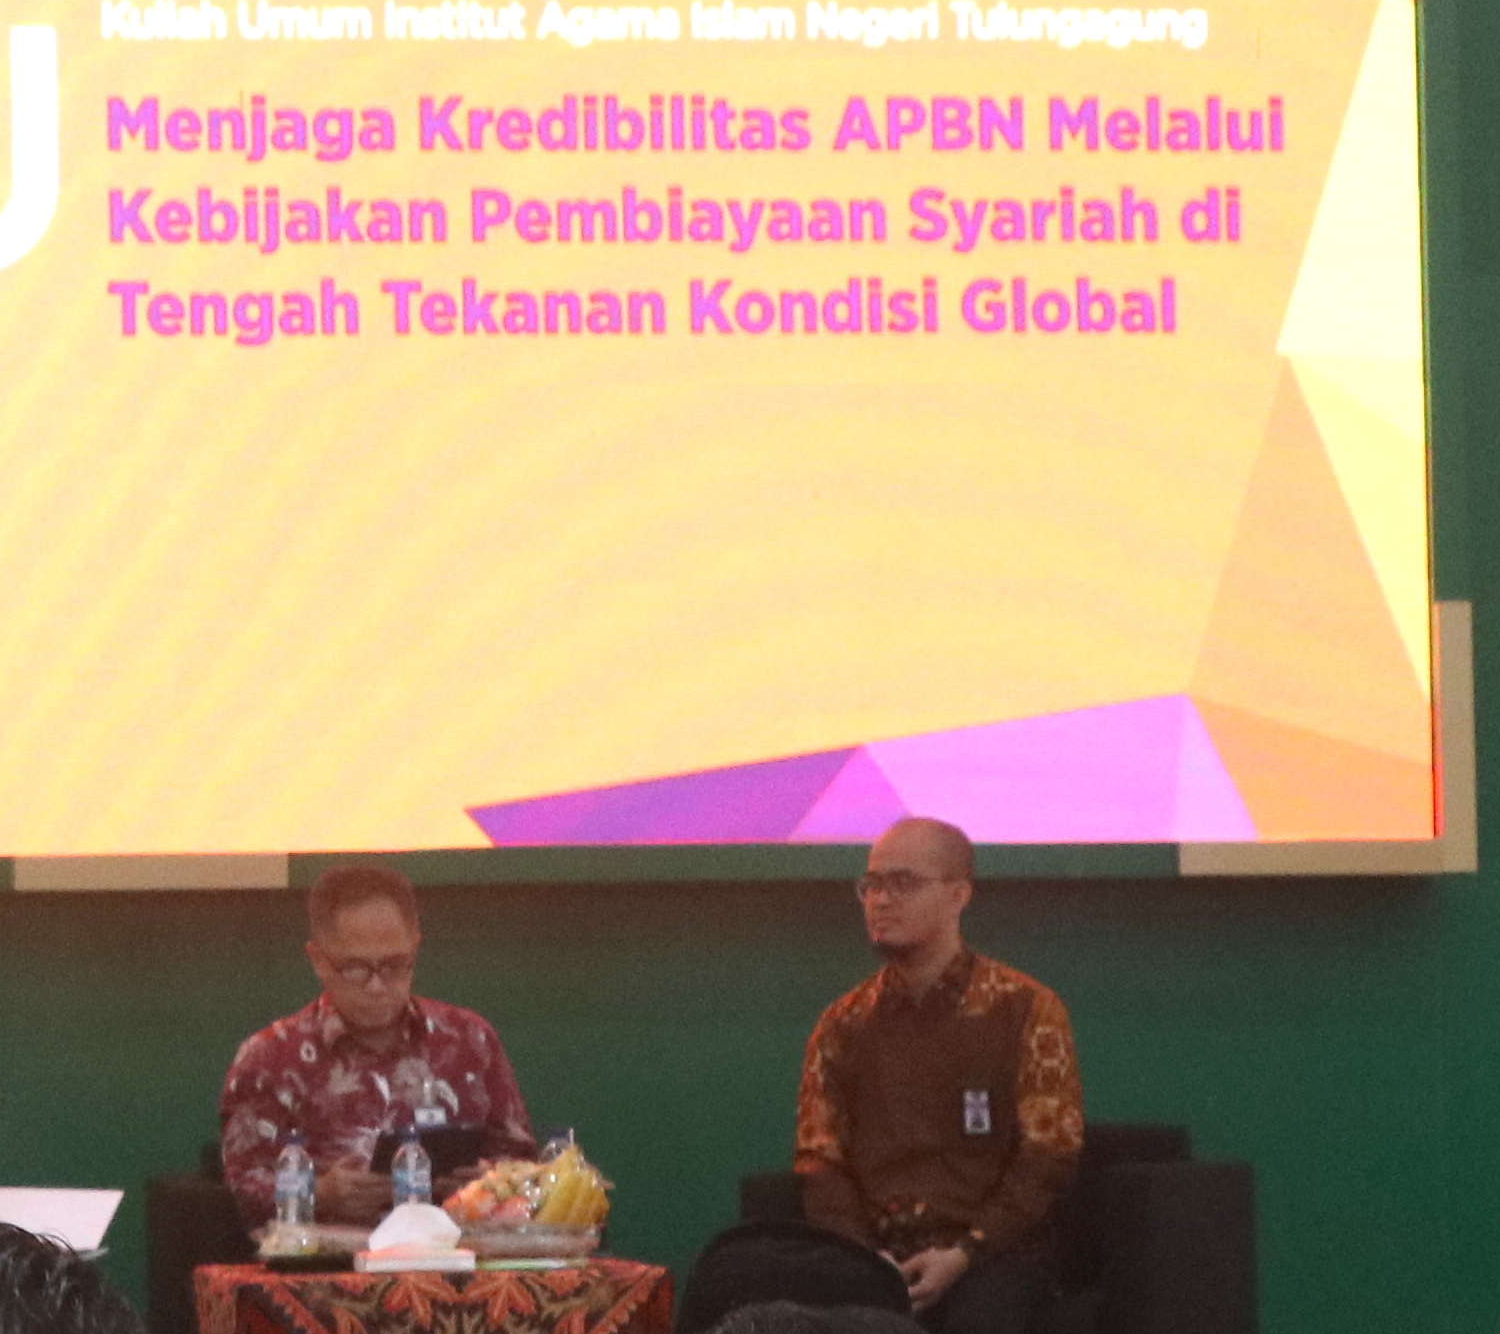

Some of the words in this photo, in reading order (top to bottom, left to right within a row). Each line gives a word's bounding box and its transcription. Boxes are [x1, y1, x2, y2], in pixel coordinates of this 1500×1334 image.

[237, 0, 372, 40] Umum
[384, 0, 525, 40] Institut
[536, 0, 680, 47] Agama
[690, 0, 796, 40] Islam
[805, 0, 939, 47] Negeri
[949, 0, 1208, 49] Tulungagung
[107, 94, 396, 163] Menjaga
[419, 94, 811, 152] Kredibilitas
[833, 97, 1024, 151] APBN
[1049, 96, 1284, 152] Melalui
[108, 186, 447, 255] Kebijakan
[471, 186, 887, 254] Pembiayaan
[909, 186, 1158, 253] Syariah
[1180, 187, 1240, 243] di
[107, 277, 359, 347] Tengah
[381, 278, 666, 335] Tekanan
[689, 277, 938, 334] Kondisi
[961, 277, 1176, 334] Global
